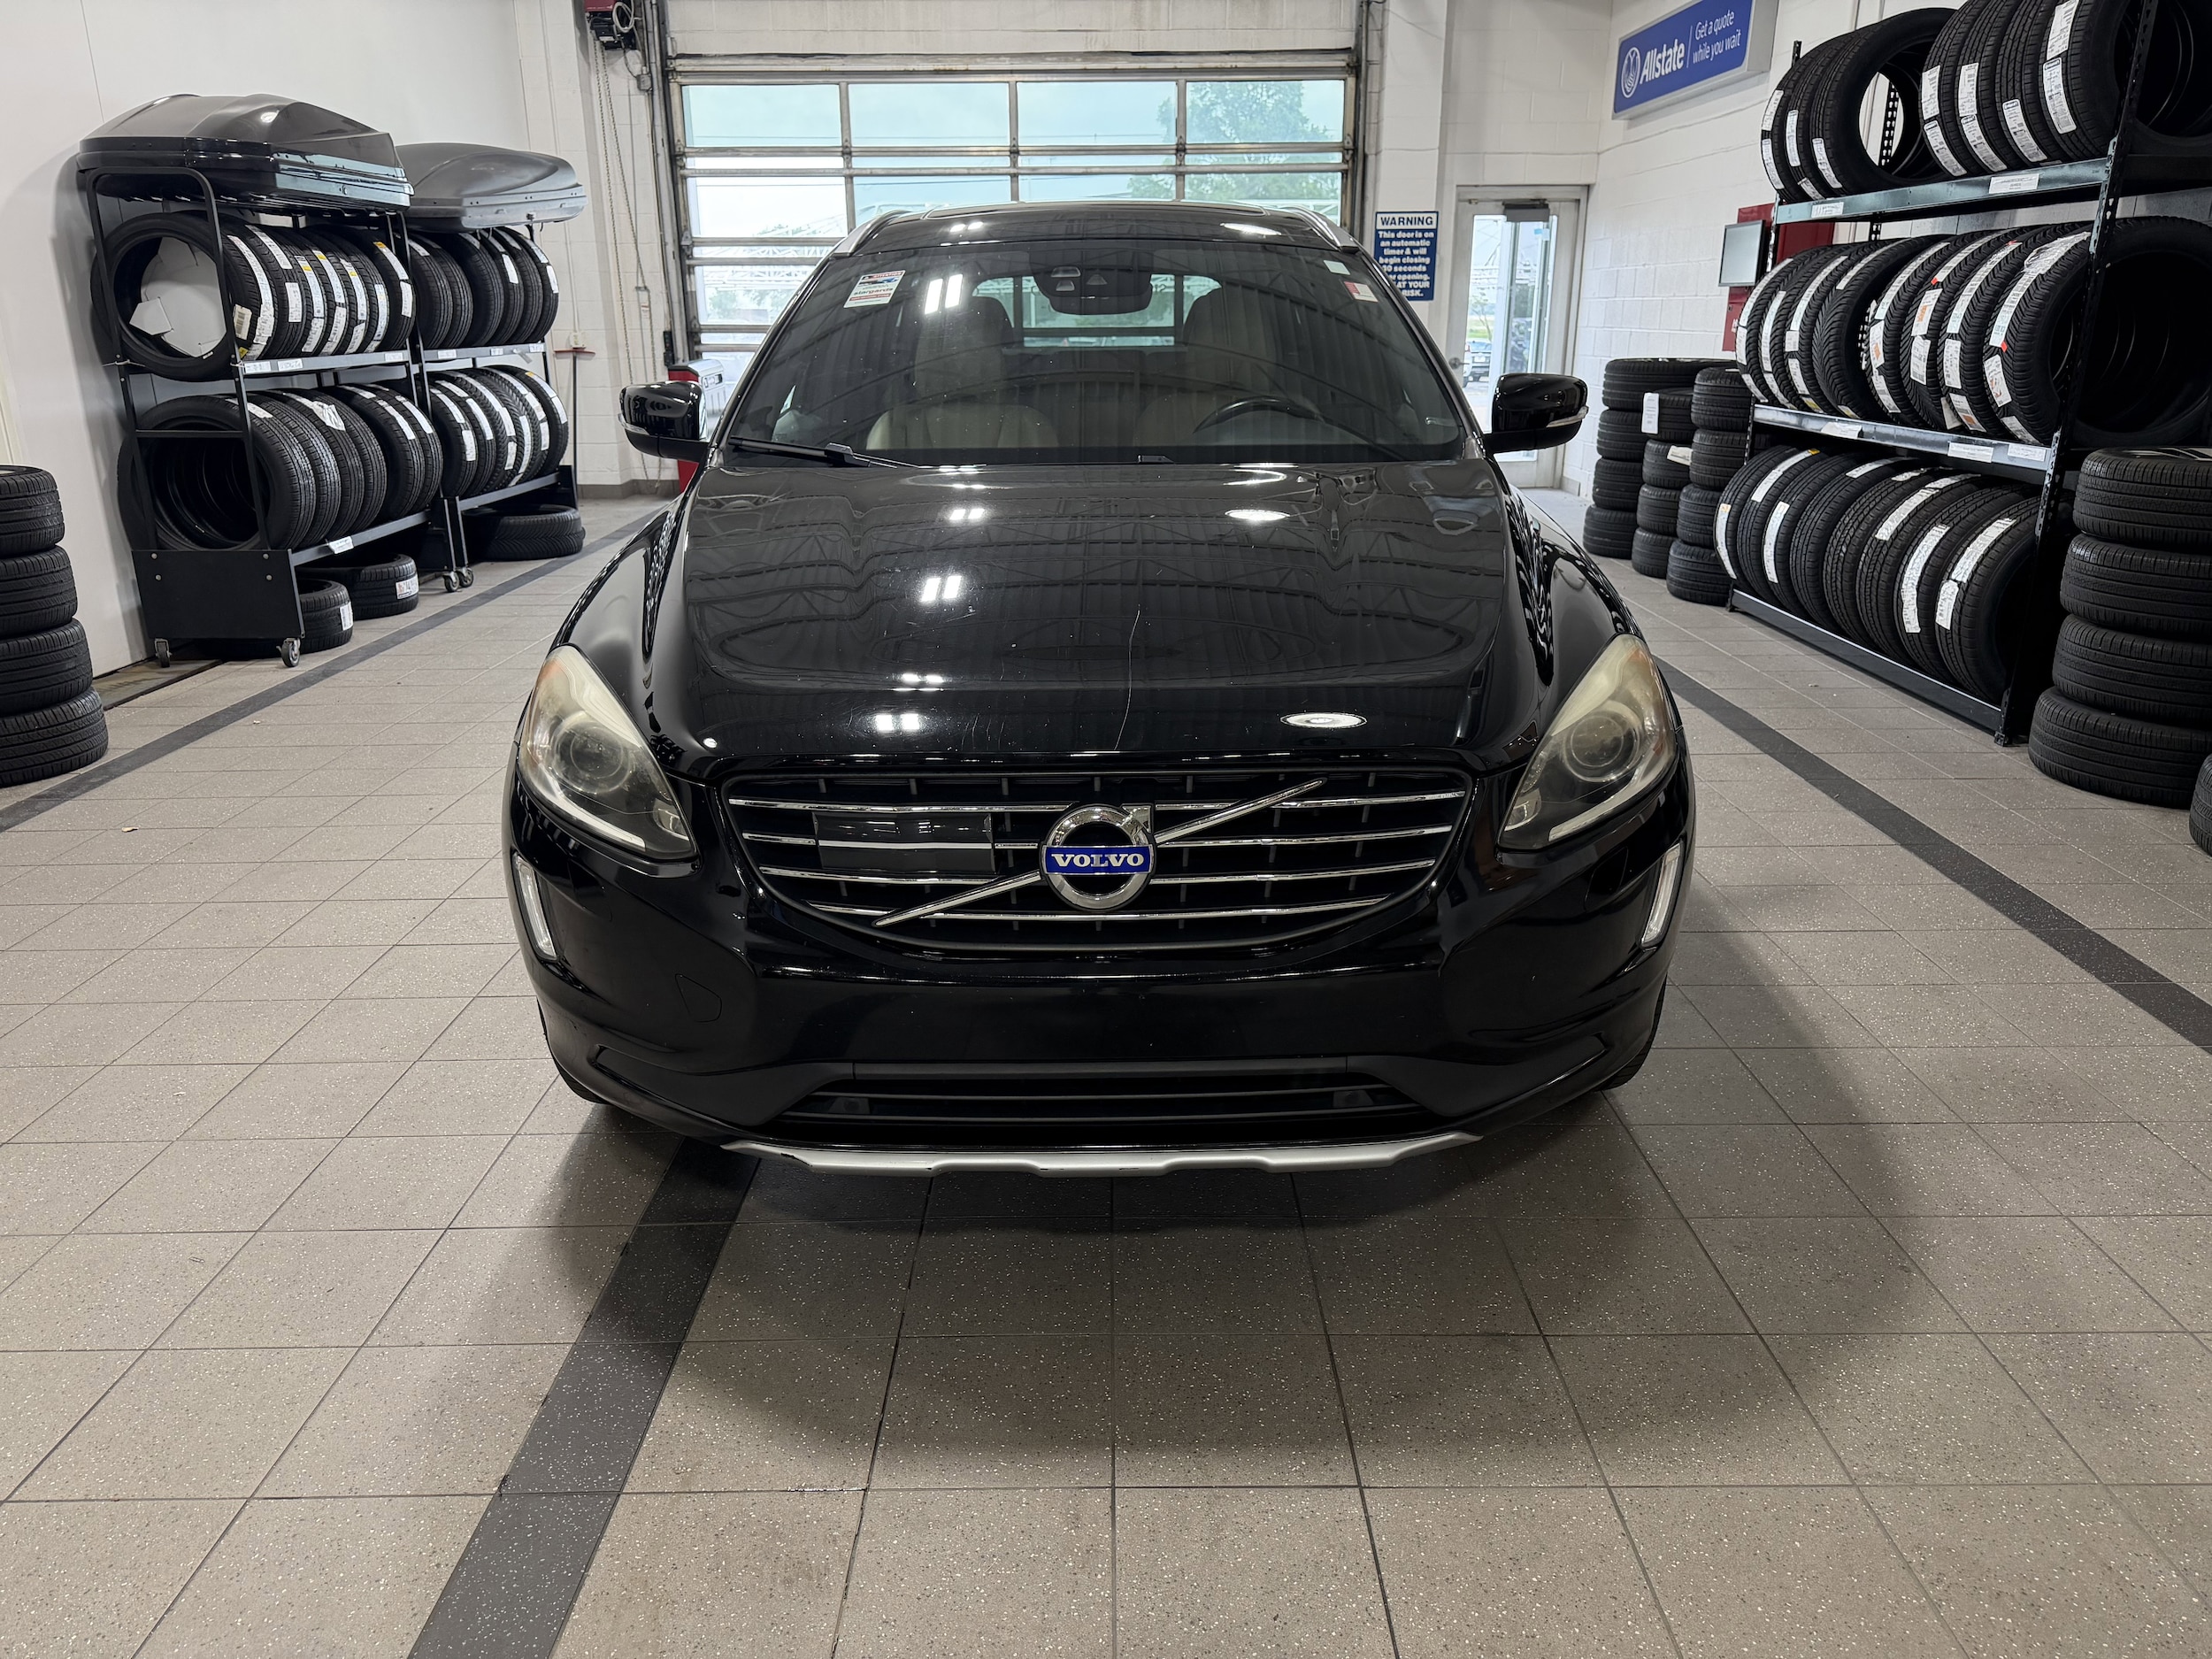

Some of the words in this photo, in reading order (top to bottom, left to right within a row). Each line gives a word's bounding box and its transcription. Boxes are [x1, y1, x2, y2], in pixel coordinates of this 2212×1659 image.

[1695, 20, 1708, 40] Get
[1708, 21, 1713, 35] a
[1714, 10, 1734, 35] quote
[1640, 39, 1685, 84] Allstate
[1693, 42, 1710, 64] while
[1710, 40, 1724, 61] you
[1725, 29, 1741, 50] wait
[1380, 217, 1433, 226] WARNING
[1051, 853, 1145, 867] VOLVO
